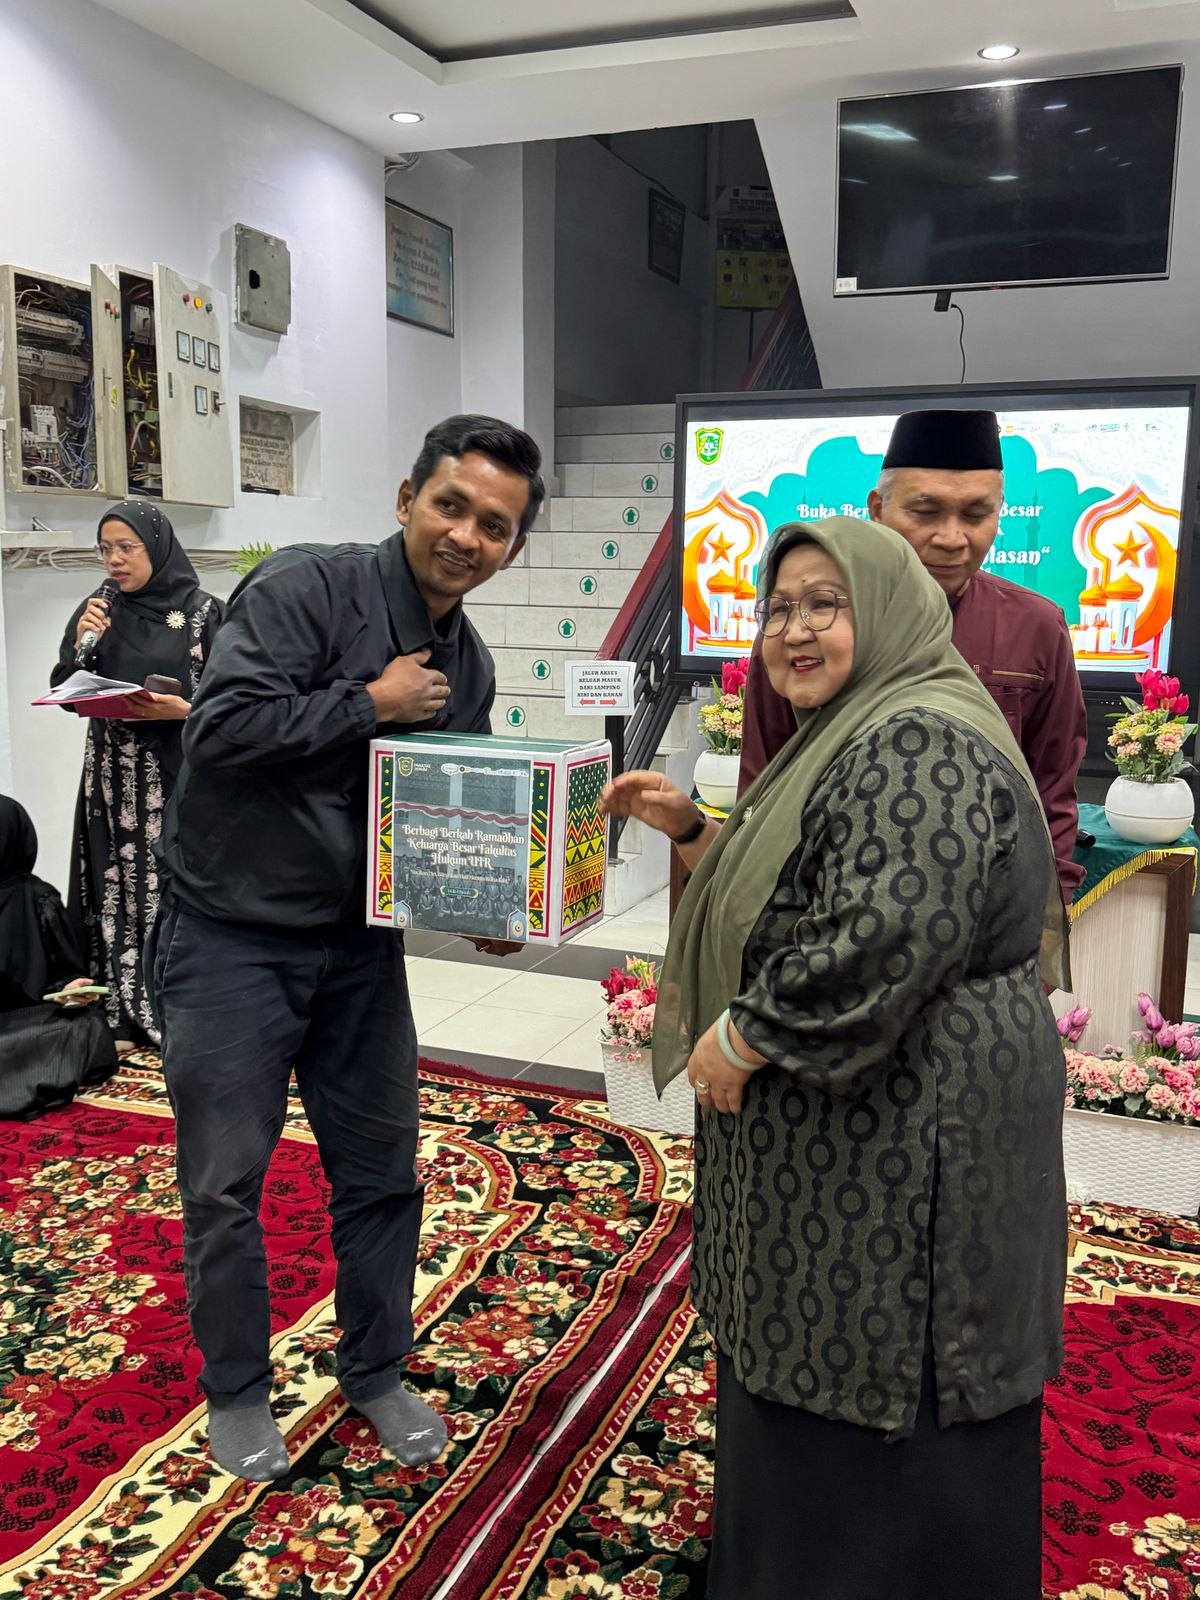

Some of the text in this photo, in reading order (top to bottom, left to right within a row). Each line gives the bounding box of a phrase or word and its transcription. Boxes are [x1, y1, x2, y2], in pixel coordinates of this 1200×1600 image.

[796, 503, 836, 518] Buka
[402, 824, 525, 845] Berbagi Berkah Ramadhan
[407, 838, 517, 858] Keluarga Besar Fakultas
[431, 852, 467, 867] Hukum
